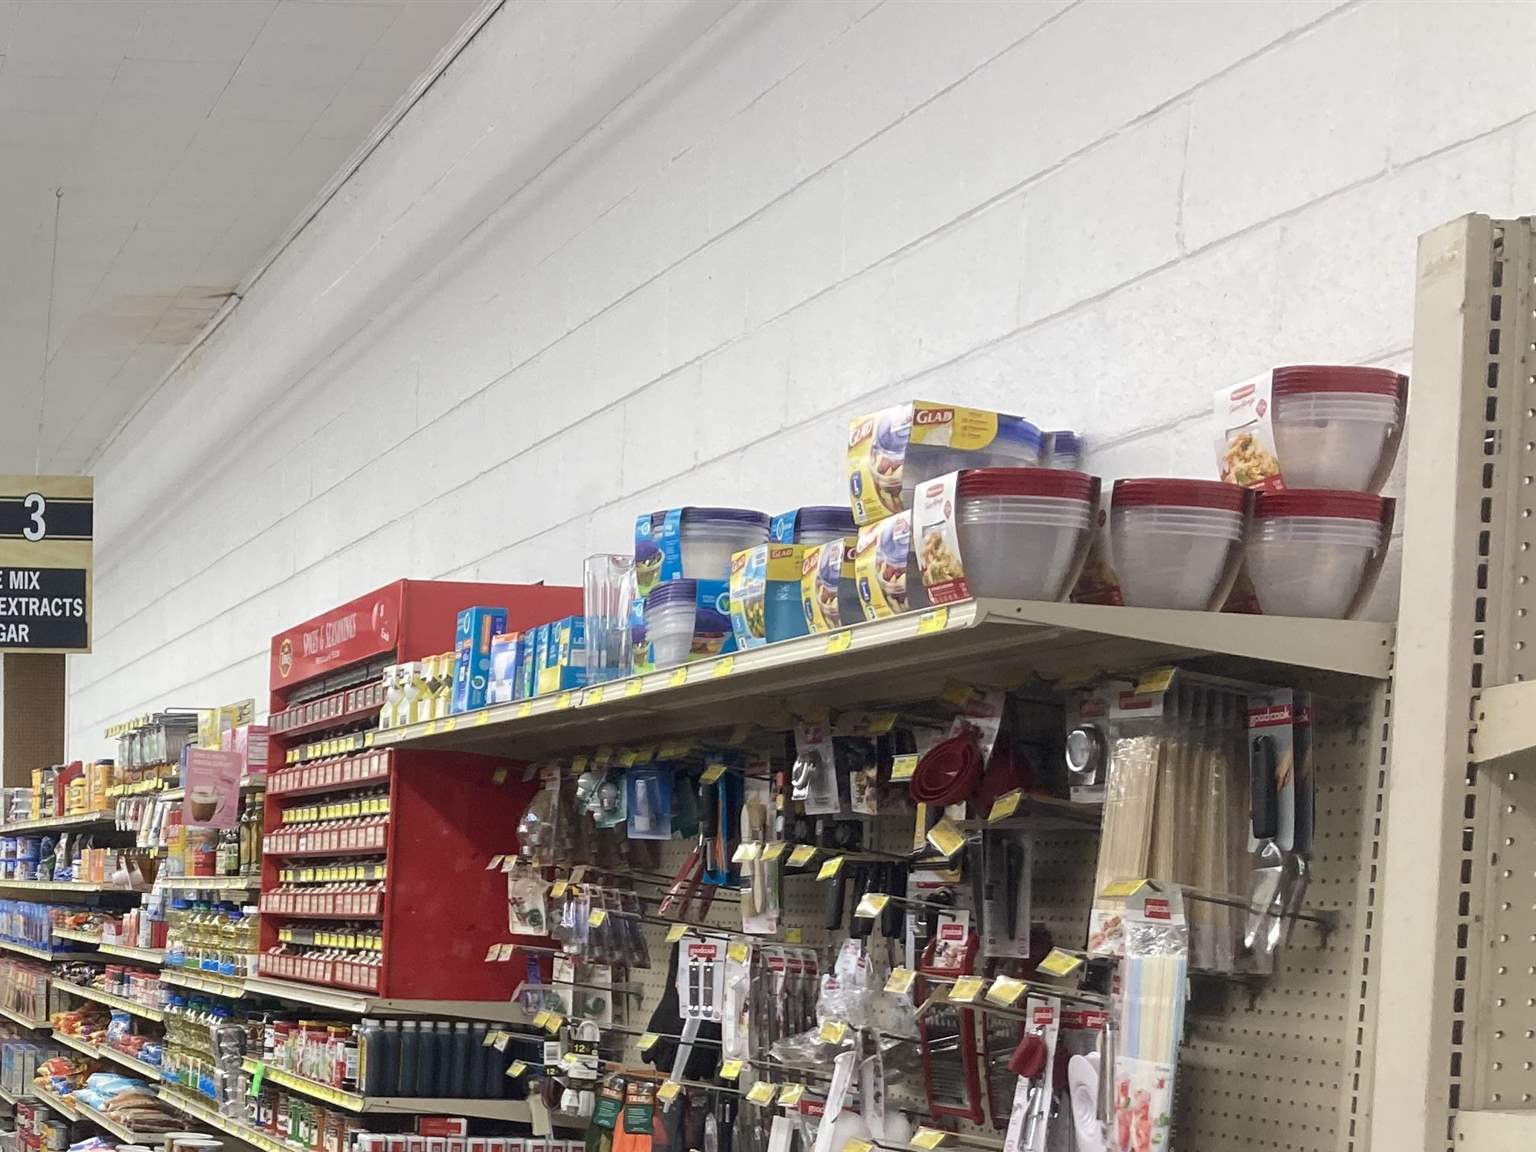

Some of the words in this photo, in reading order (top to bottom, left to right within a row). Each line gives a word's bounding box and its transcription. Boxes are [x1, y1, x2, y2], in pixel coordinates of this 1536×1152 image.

[916, 410, 954, 424] GLAD
[23, 493, 47, 542] 3
[9, 570, 41, 591] MIX
[574, 1044, 585, 1053] 12
